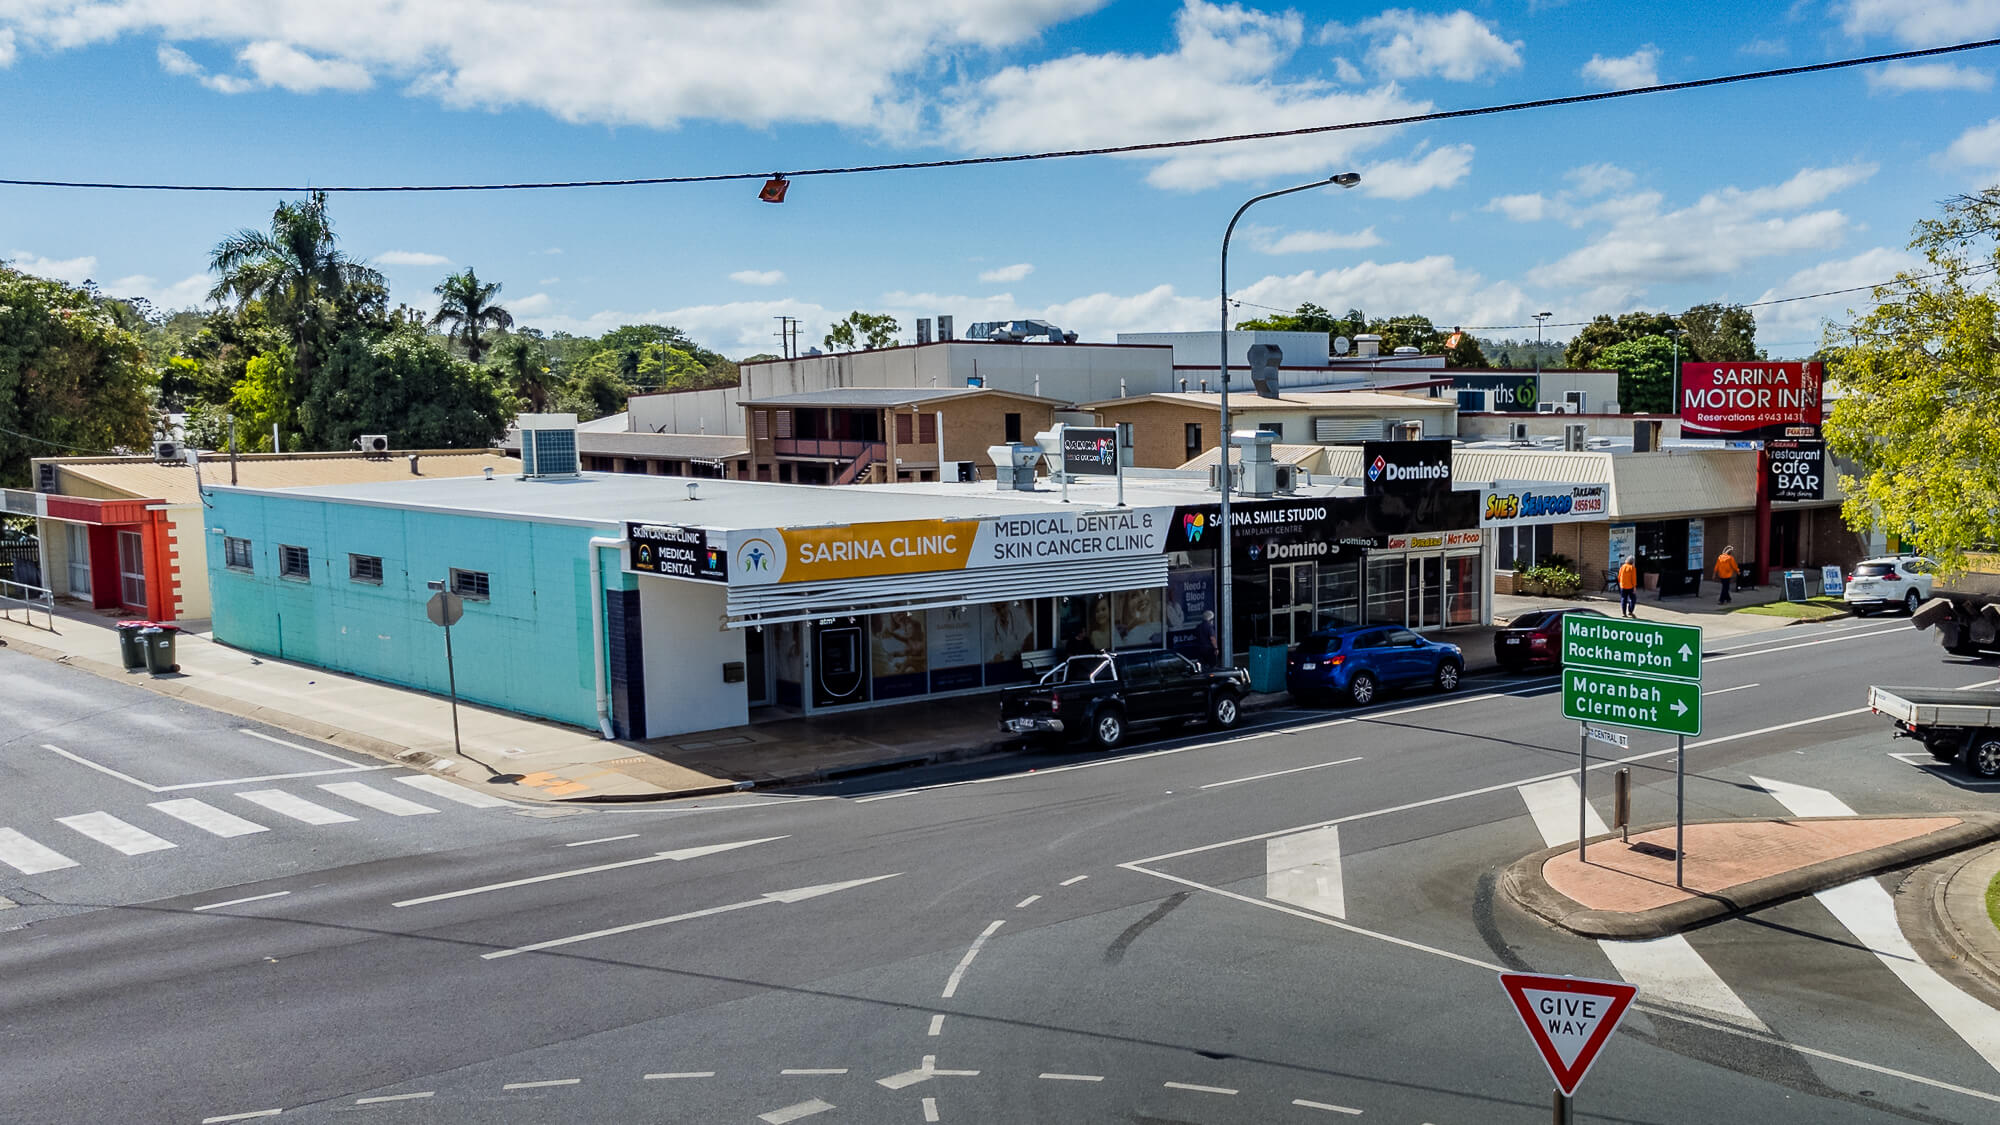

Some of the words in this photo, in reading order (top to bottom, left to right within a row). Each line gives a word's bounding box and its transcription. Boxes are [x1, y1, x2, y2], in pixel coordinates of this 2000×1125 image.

[1712, 368, 1789, 385] SARINA
[1684, 388, 1772, 409] MOTOR
[1778, 388, 1817, 409] INN
[1697, 413, 1755, 422] Reservations
[1757, 412, 1782, 421] 4943
[1784, 412, 1803, 421] 1431
[1771, 449, 1820, 460] restaurant
[1386, 460, 1449, 480] Domino's
[1771, 460, 1810, 474] cafe
[1778, 475, 1819, 490] BAR
[1573, 487, 1602, 497] TAKEAWAY
[1485, 493, 1519, 520] SUE'S
[1520, 492, 1573, 517] SEAFOOD
[1574, 499, 1601, 512] 49561439
[1209, 512, 1252, 527] SAINA
[1253, 509, 1286, 524] SMILE
[1287, 507, 1327, 522] STUDIO
[995, 519, 1073, 538] MEDICAL,
[1076, 515, 1138, 532] DENTAL
[1142, 513, 1152, 528] &
[1242, 527, 1273, 536] IMPLANT
[1275, 525, 1303, 535] CENTRE
[633, 527, 648, 538] SKIN
[677, 532, 700, 544] CLINIC
[1447, 535, 1462, 545] HOT
[1463, 533, 1480, 543] FOOD
[658, 547, 696, 561] MEDICAL
[800, 542, 886, 564] SARINA
[889, 534, 957, 557] CLINIC
[994, 542, 1032, 559] SKIN
[1036, 537, 1102, 556] CANCER
[1105, 534, 1154, 551] CLINIC
[1267, 541, 1340, 559] Dominos
[661, 562, 695, 575] DENTAL
[1183, 581, 1201, 590] Need
[1185, 592, 1205, 601] Blood
[1187, 601, 1204, 612] Test?
[1569, 622, 1663, 648] Marlborough
[1569, 643, 1672, 667] Rockhampton
[1573, 677, 1661, 702] Moranbah
[1576, 697, 1658, 722] Clermont
[1594, 729, 1617, 743] CENTRAL
[1619, 735, 1627, 744] ST
[1540, 997, 1596, 1018] GIVE
[1549, 1020, 1587, 1036] WAY
